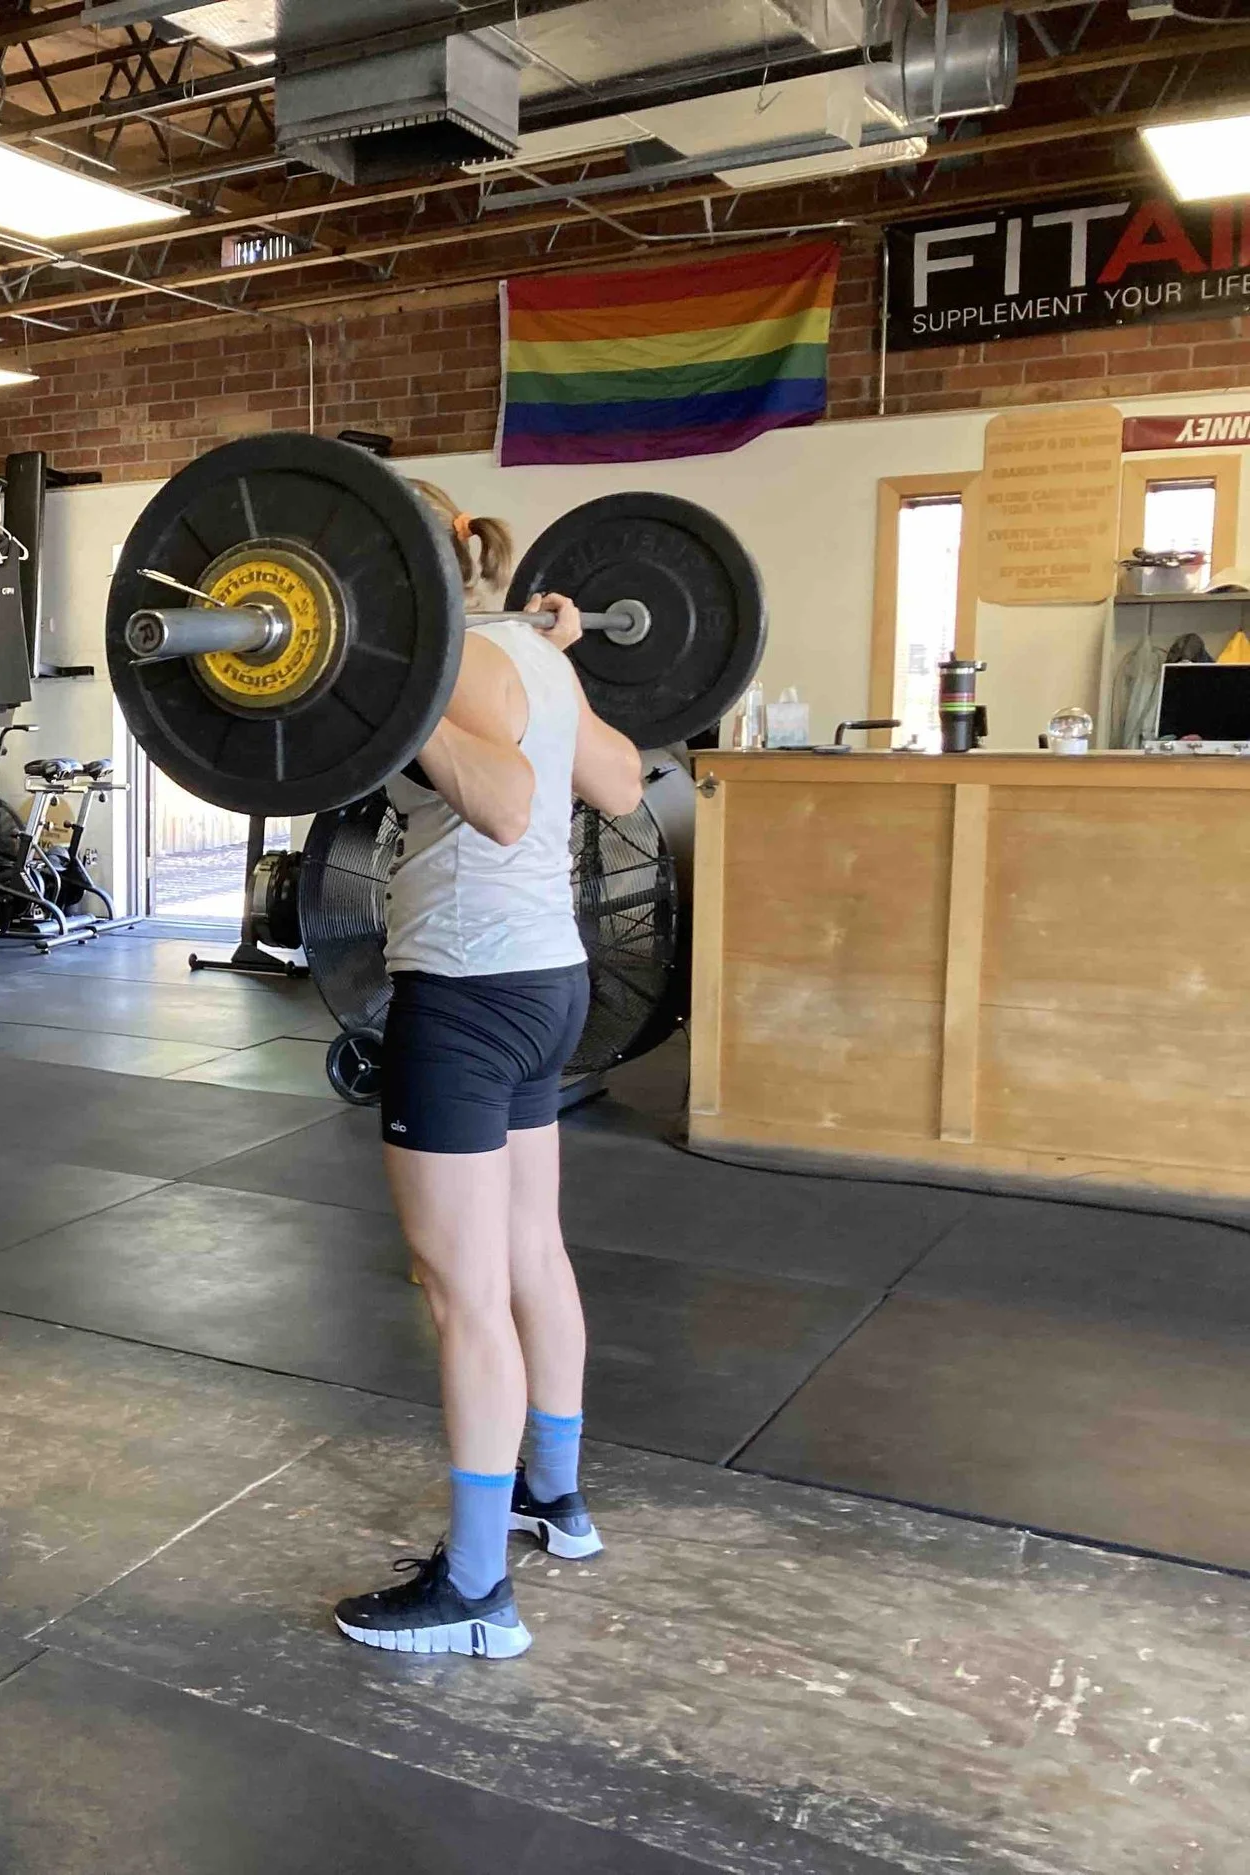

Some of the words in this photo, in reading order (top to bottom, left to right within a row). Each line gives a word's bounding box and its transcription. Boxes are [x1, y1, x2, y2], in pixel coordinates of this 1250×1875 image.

[913, 198, 1250, 307] FITAI
[912, 293, 1088, 334] SUPPLEMENT
[1104, 281, 1182, 310] YOUR
[1174, 415, 1250, 442] NNEY
[390, 1119, 407, 1132] alo
